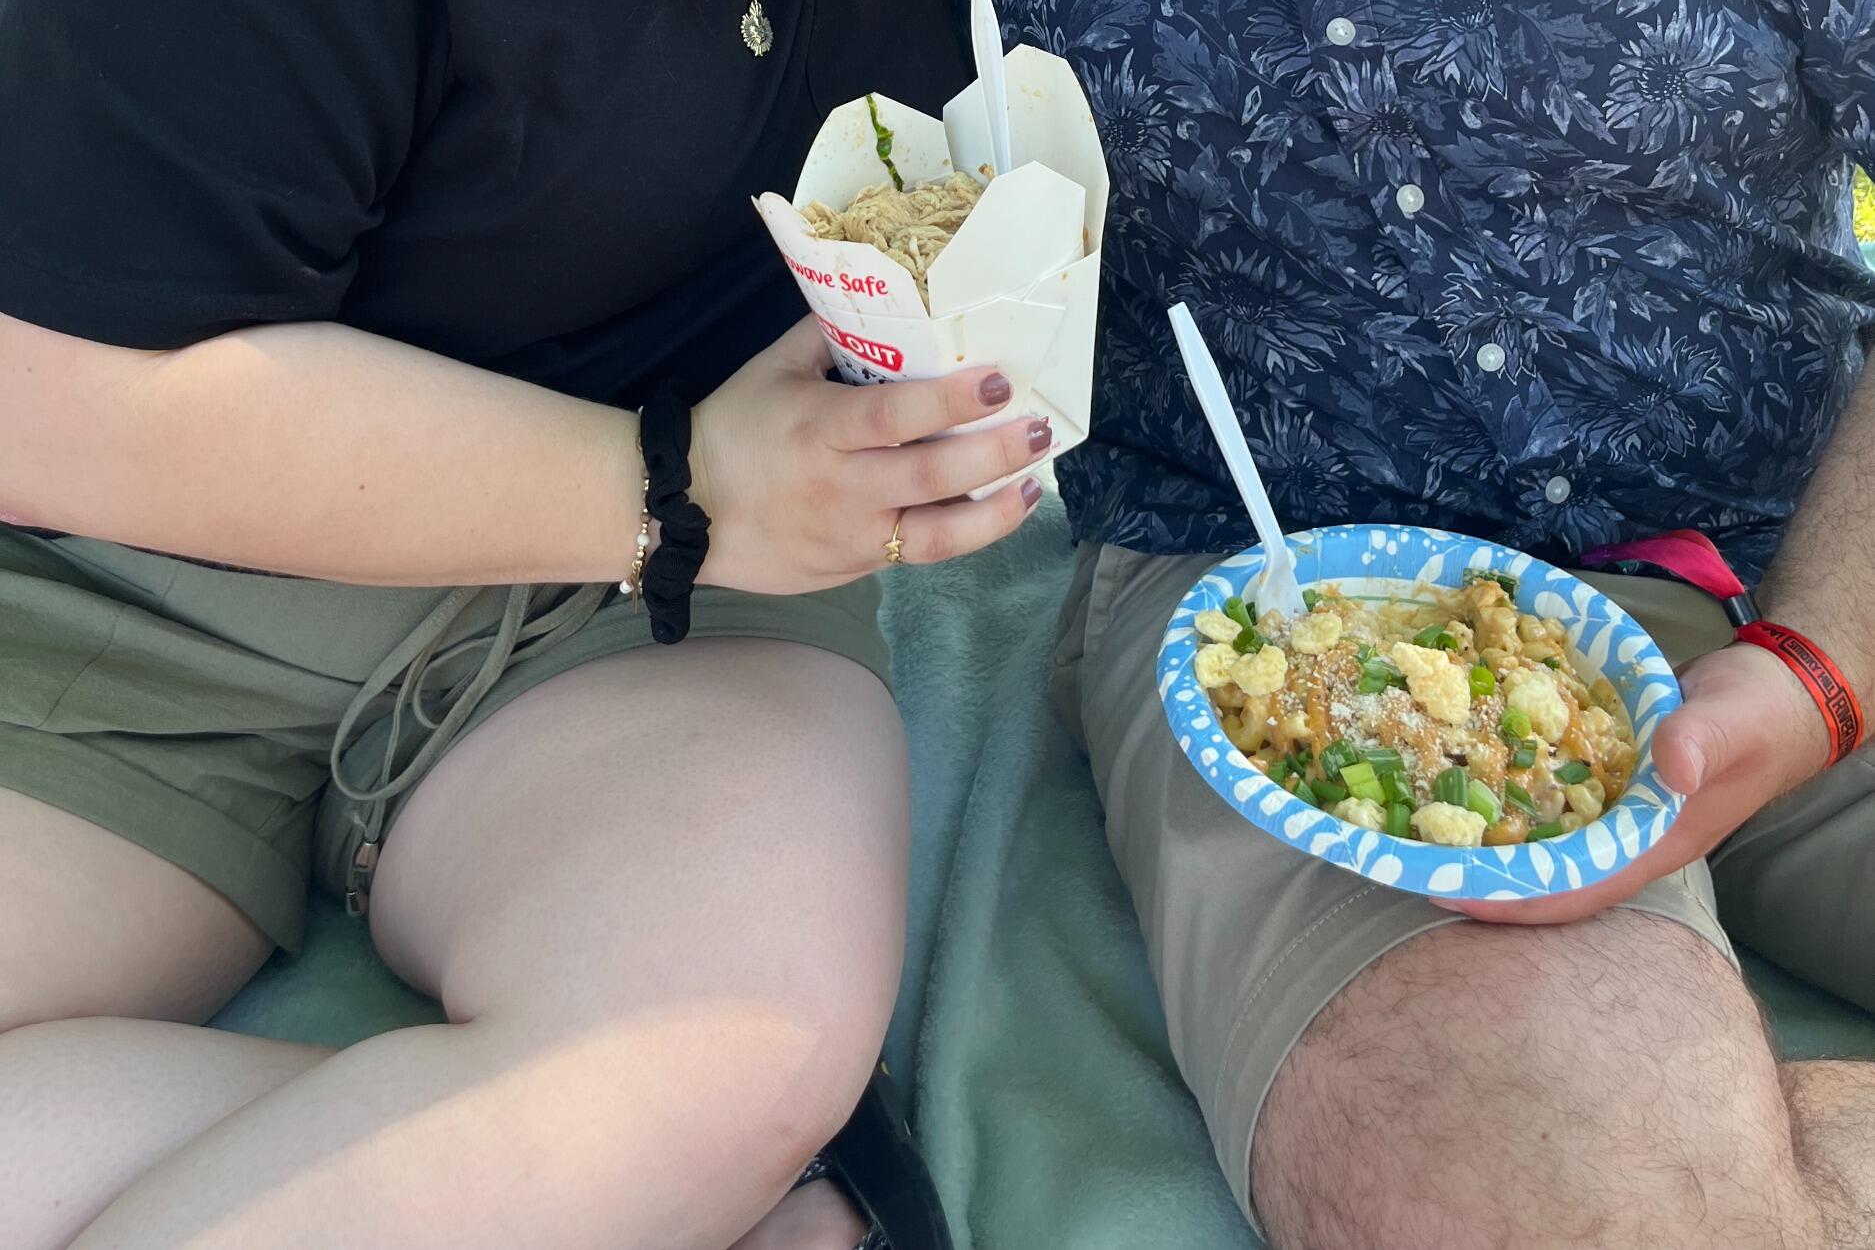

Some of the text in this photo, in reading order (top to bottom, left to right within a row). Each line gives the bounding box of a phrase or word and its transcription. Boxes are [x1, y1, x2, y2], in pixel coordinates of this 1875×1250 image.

[839, 272, 889, 297] Safe
[846, 336, 896, 366] OUT
[1818, 671, 1835, 695] HILL
